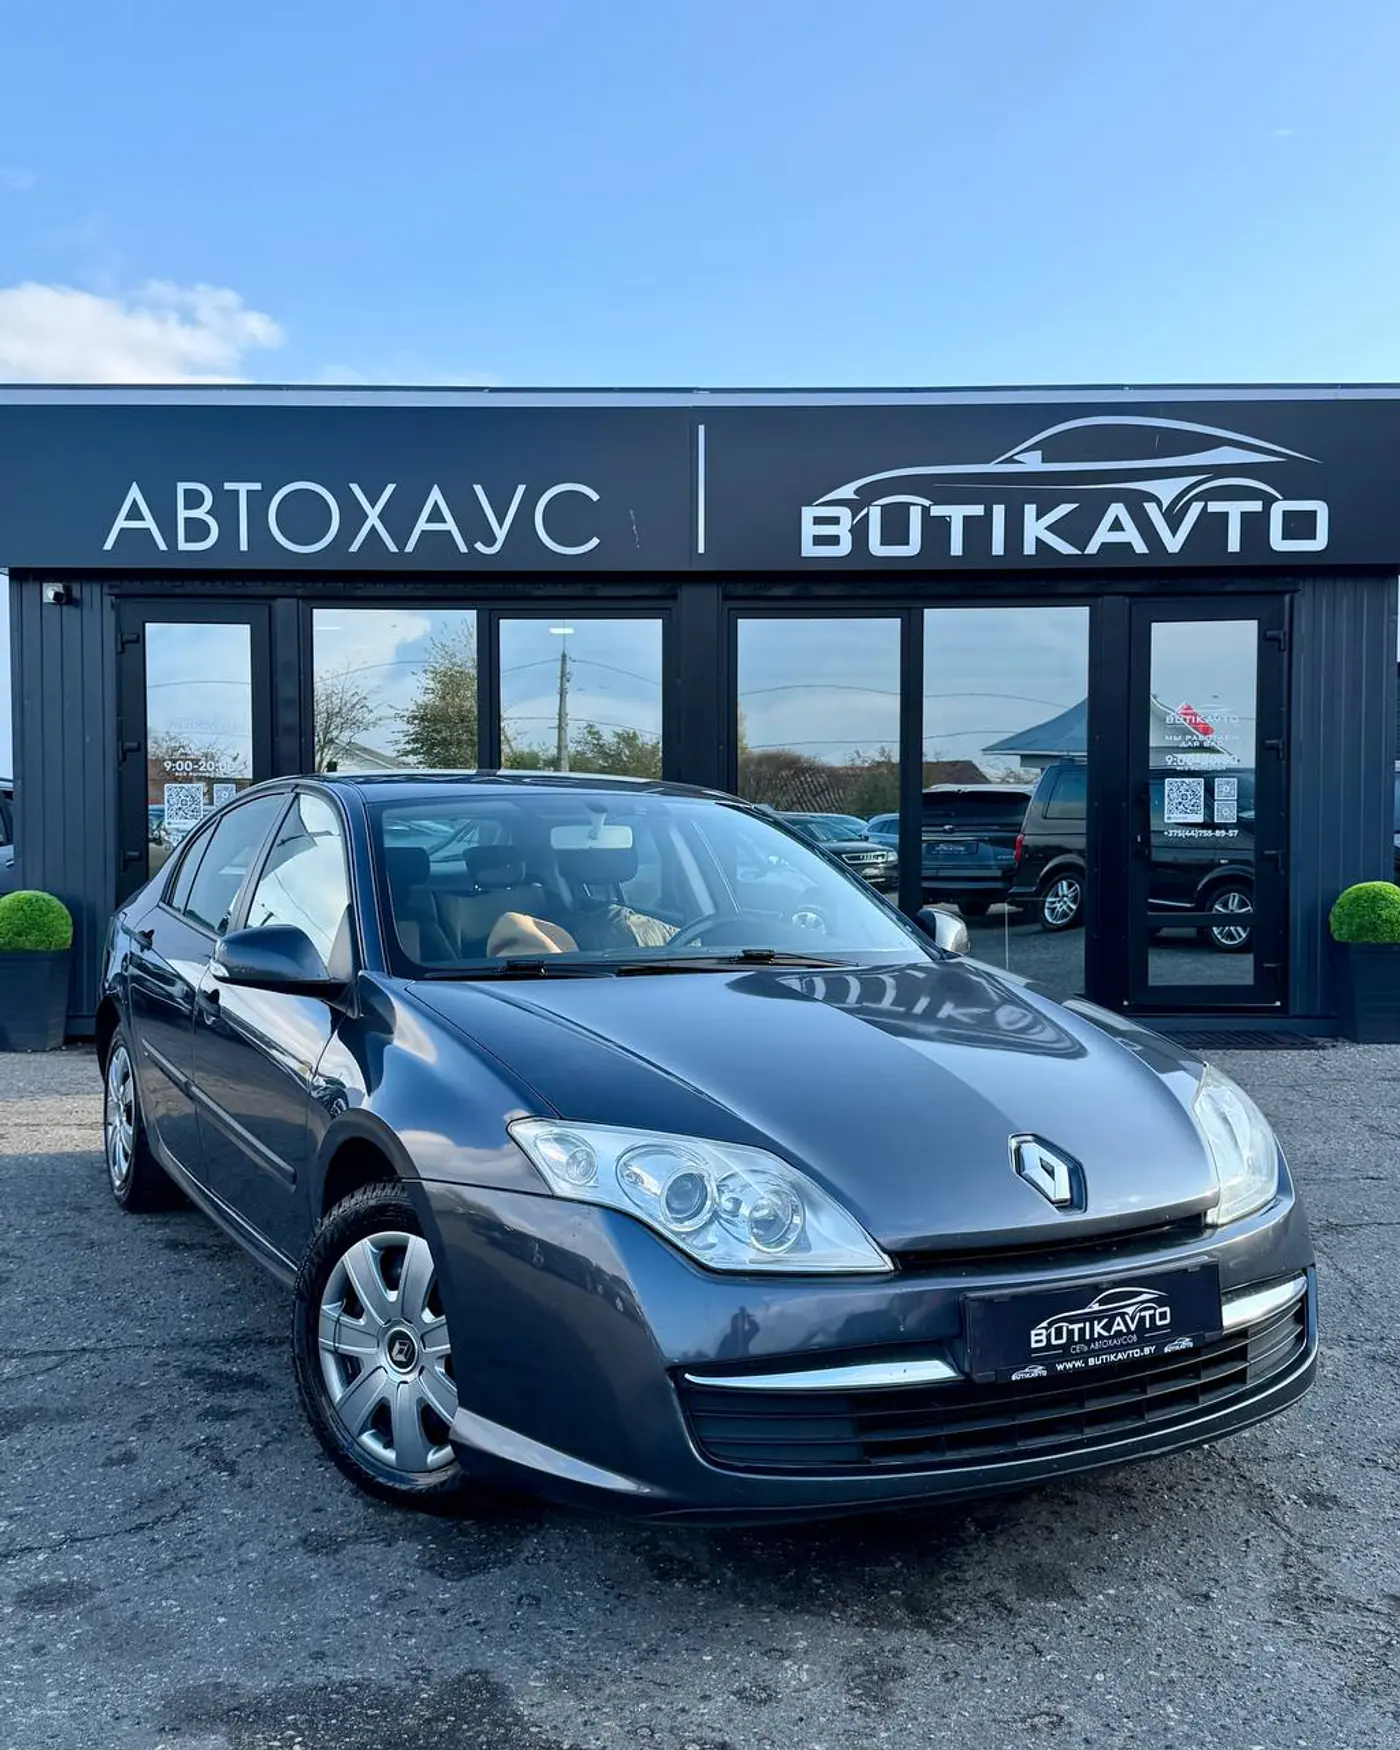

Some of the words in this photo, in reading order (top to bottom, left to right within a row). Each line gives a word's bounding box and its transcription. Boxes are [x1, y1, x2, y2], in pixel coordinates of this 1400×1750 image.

[103, 481, 602, 556] АВТОХАУС
[800, 498, 1329, 557] BUTIKAVTO
[164, 760, 235, 771] 9:00-20:00
[1030, 1306, 1171, 1349] BUTIKAVTO
[1089, 1334, 1138, 1350] АВТОХАУСОВ
[1088, 1345, 1156, 1366] BUTIKAVTO.BY
